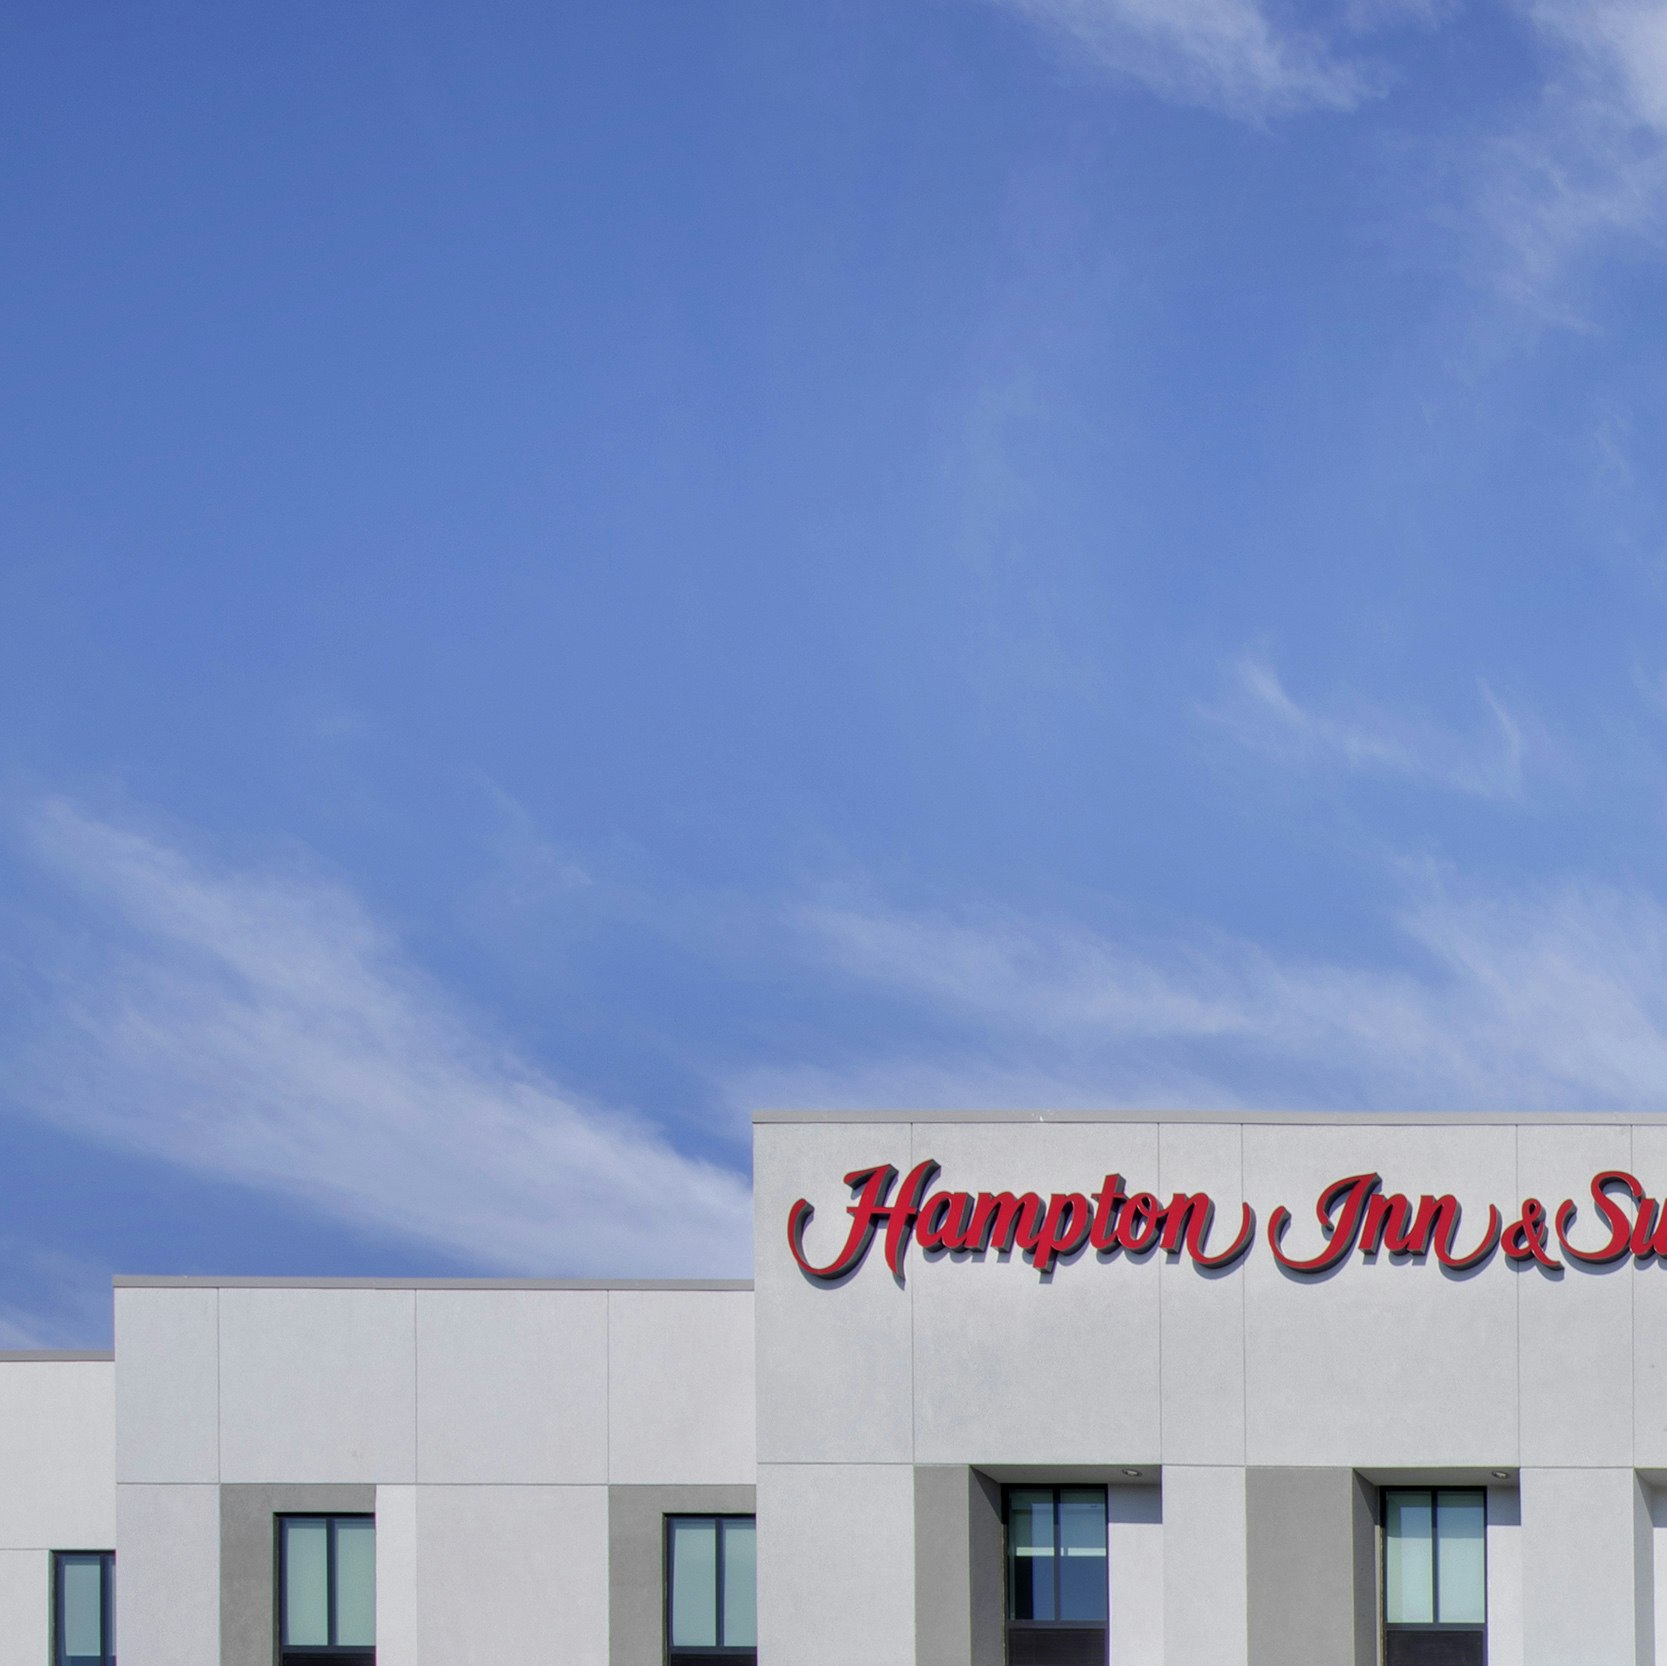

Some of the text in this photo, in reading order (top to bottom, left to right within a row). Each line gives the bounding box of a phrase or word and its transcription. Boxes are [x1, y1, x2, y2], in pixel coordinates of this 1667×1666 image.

[787, 1159, 1255, 1282] Hampton
[1268, 1172, 1500, 1272] Inn
[1501, 1199, 1564, 1270] &
